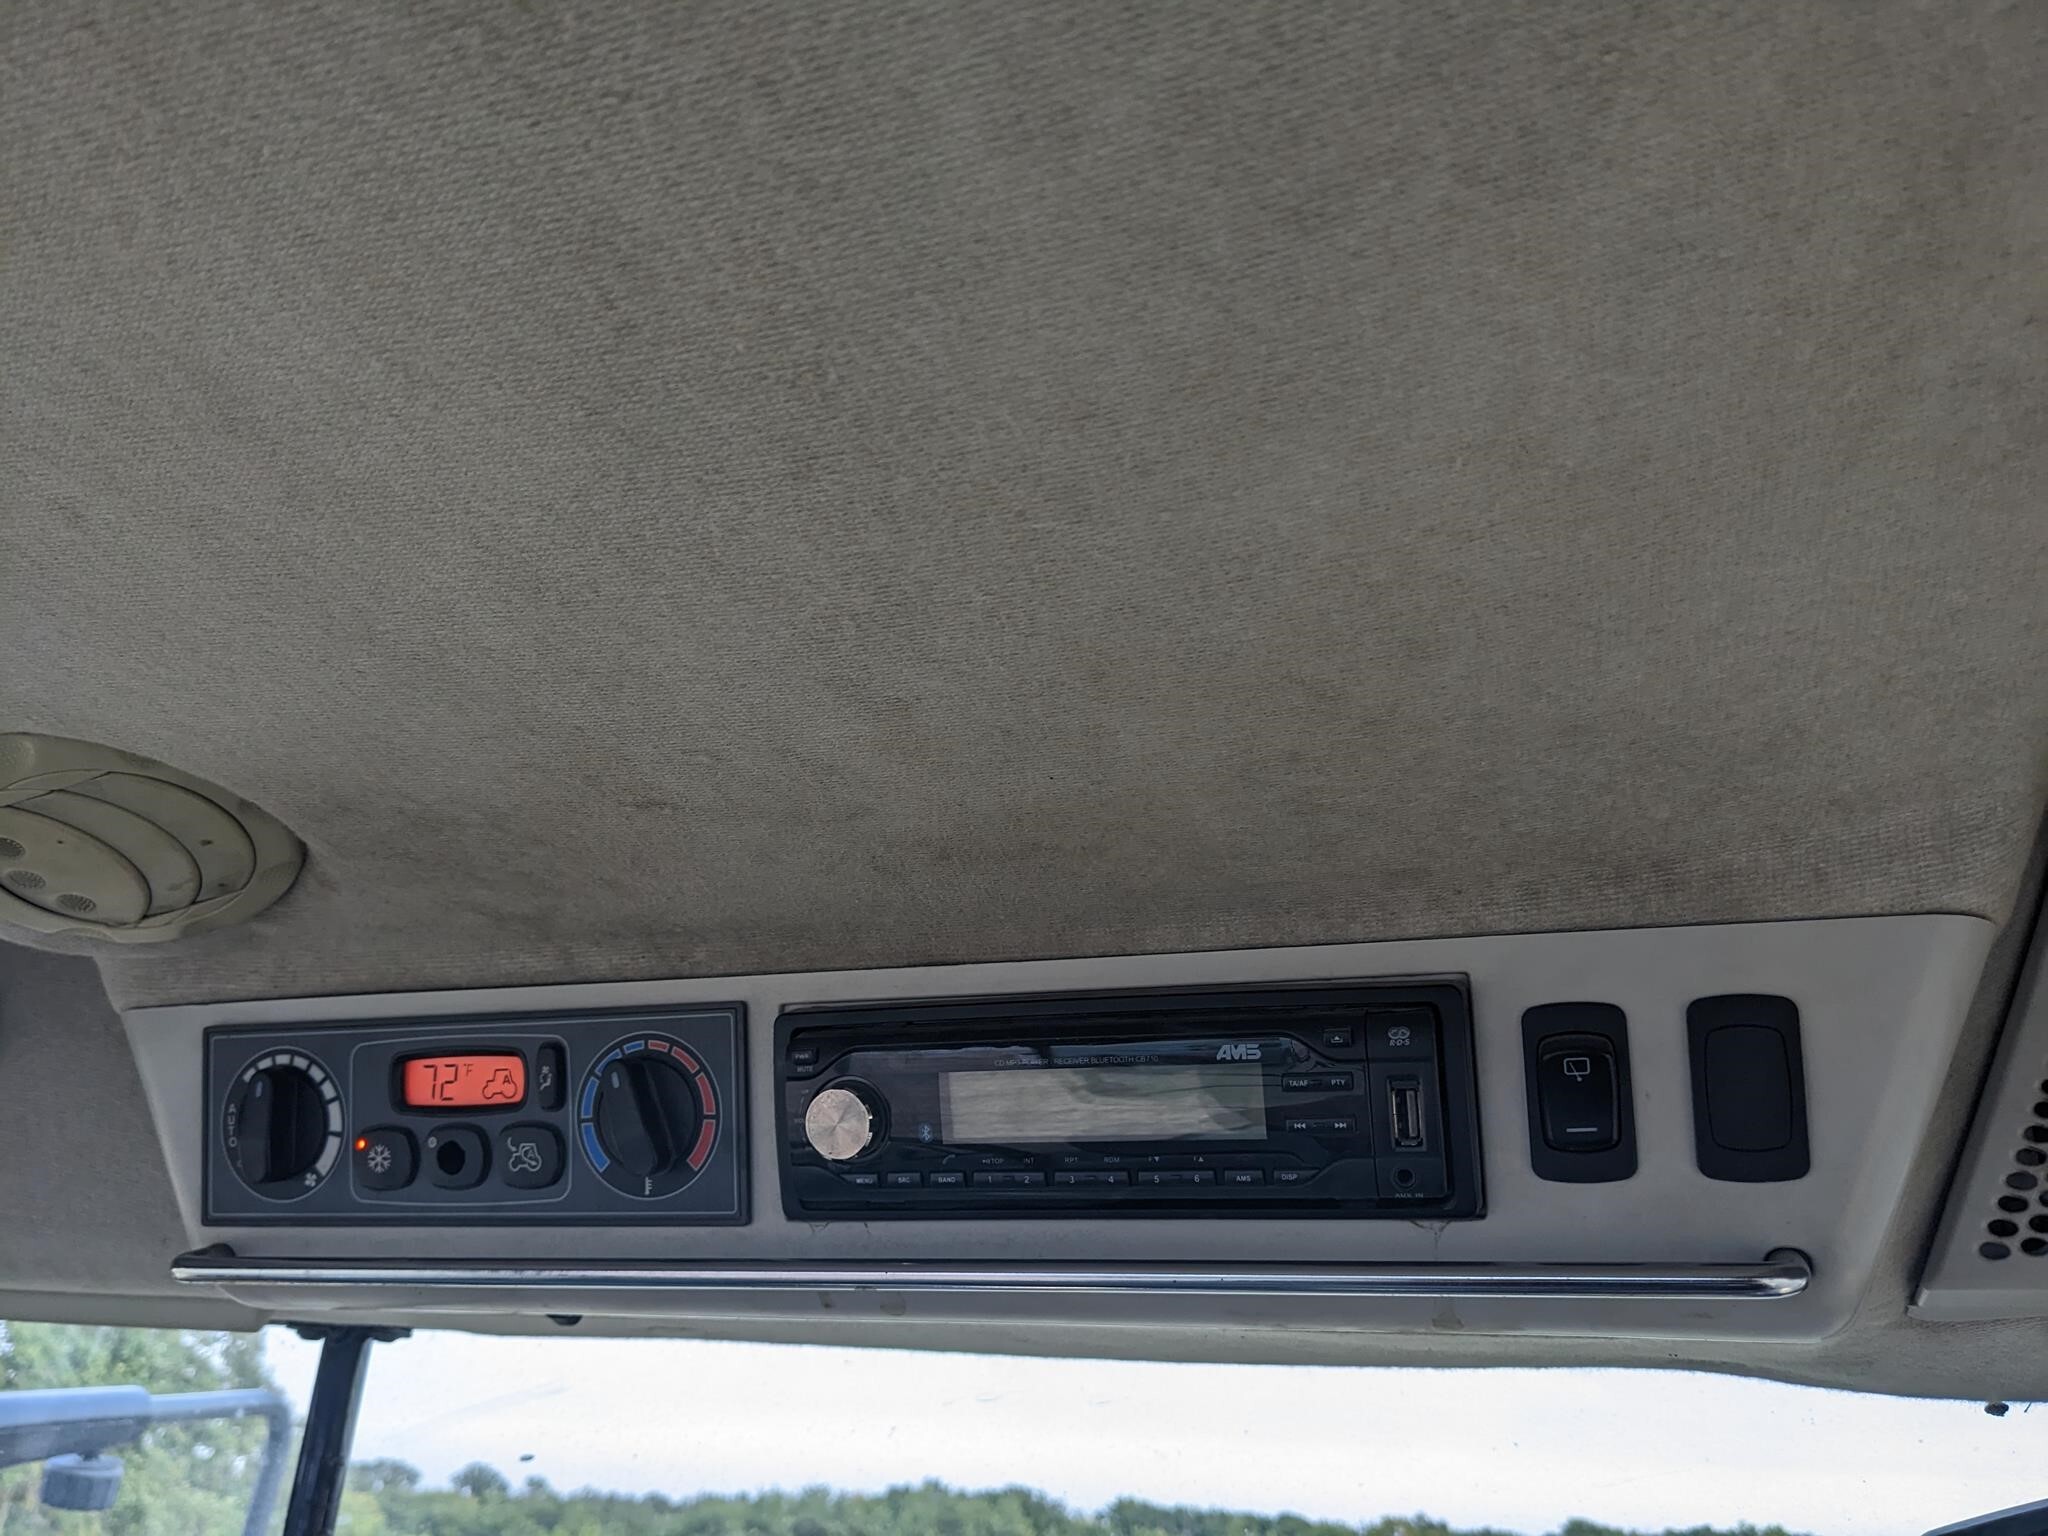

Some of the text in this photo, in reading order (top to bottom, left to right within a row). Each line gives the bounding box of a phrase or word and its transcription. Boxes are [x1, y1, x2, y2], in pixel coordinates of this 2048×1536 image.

[1215, 1043, 1262, 1061] AMS
[227, 1103, 238, 1148] AUTO
[938, 1176, 956, 1184] BAND
[1023, 1175, 1031, 1184] 2
[1069, 1175, 1076, 1184] 3
[1107, 1175, 1115, 1184] 4
[1153, 1174, 1160, 1184] 5
[1193, 1174, 1200, 1183] 6
